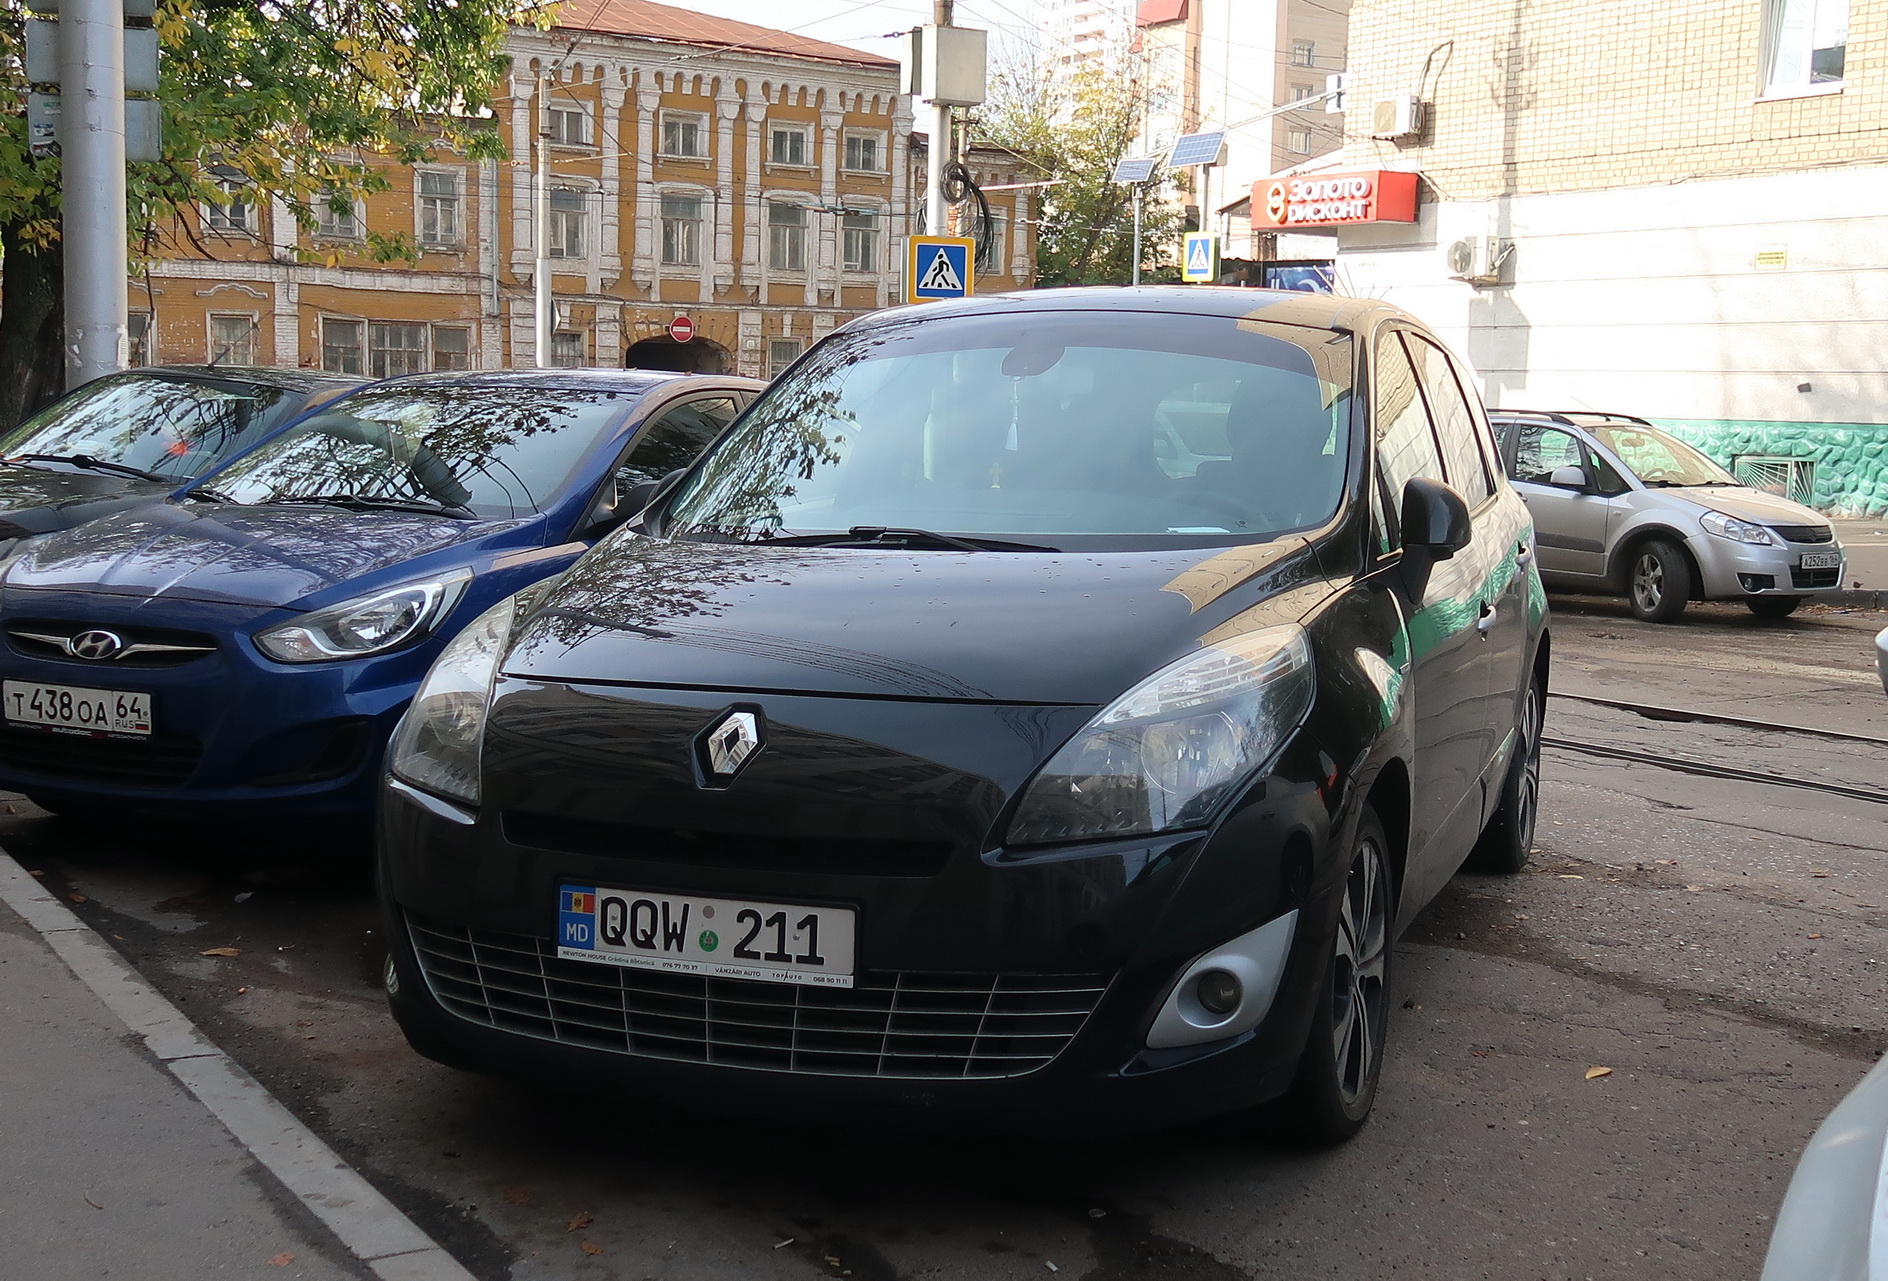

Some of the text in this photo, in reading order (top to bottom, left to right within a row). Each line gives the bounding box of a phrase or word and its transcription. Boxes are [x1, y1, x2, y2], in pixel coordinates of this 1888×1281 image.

[114, 718, 134, 729] RUS
[566, 922, 589, 943] MD
[600, 896, 825, 965] QQW 211
[562, 950, 587, 958] NEWTON
[587, 952, 606, 961] HOUSE
